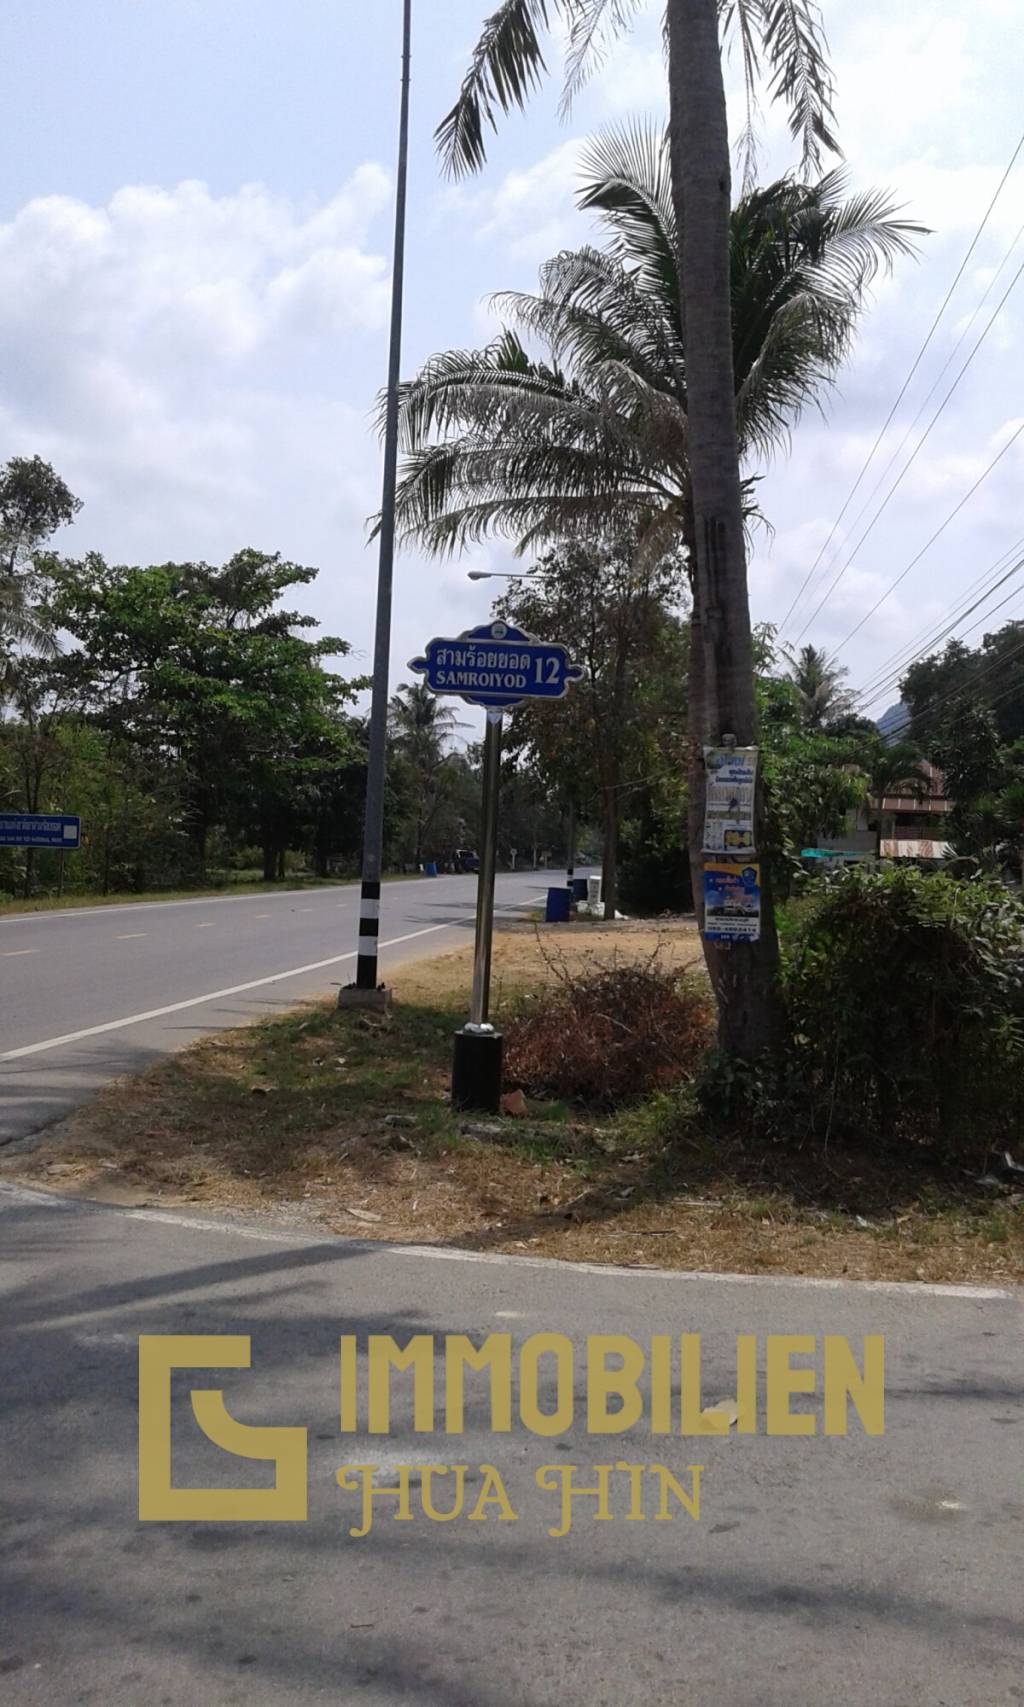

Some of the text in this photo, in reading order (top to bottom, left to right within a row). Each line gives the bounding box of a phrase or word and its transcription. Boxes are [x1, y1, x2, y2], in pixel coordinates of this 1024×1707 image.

[436, 645, 531, 670] สามร้อยยอด
[436, 670, 527, 688] SAMROIYOD
[535, 657, 560, 684] 12
